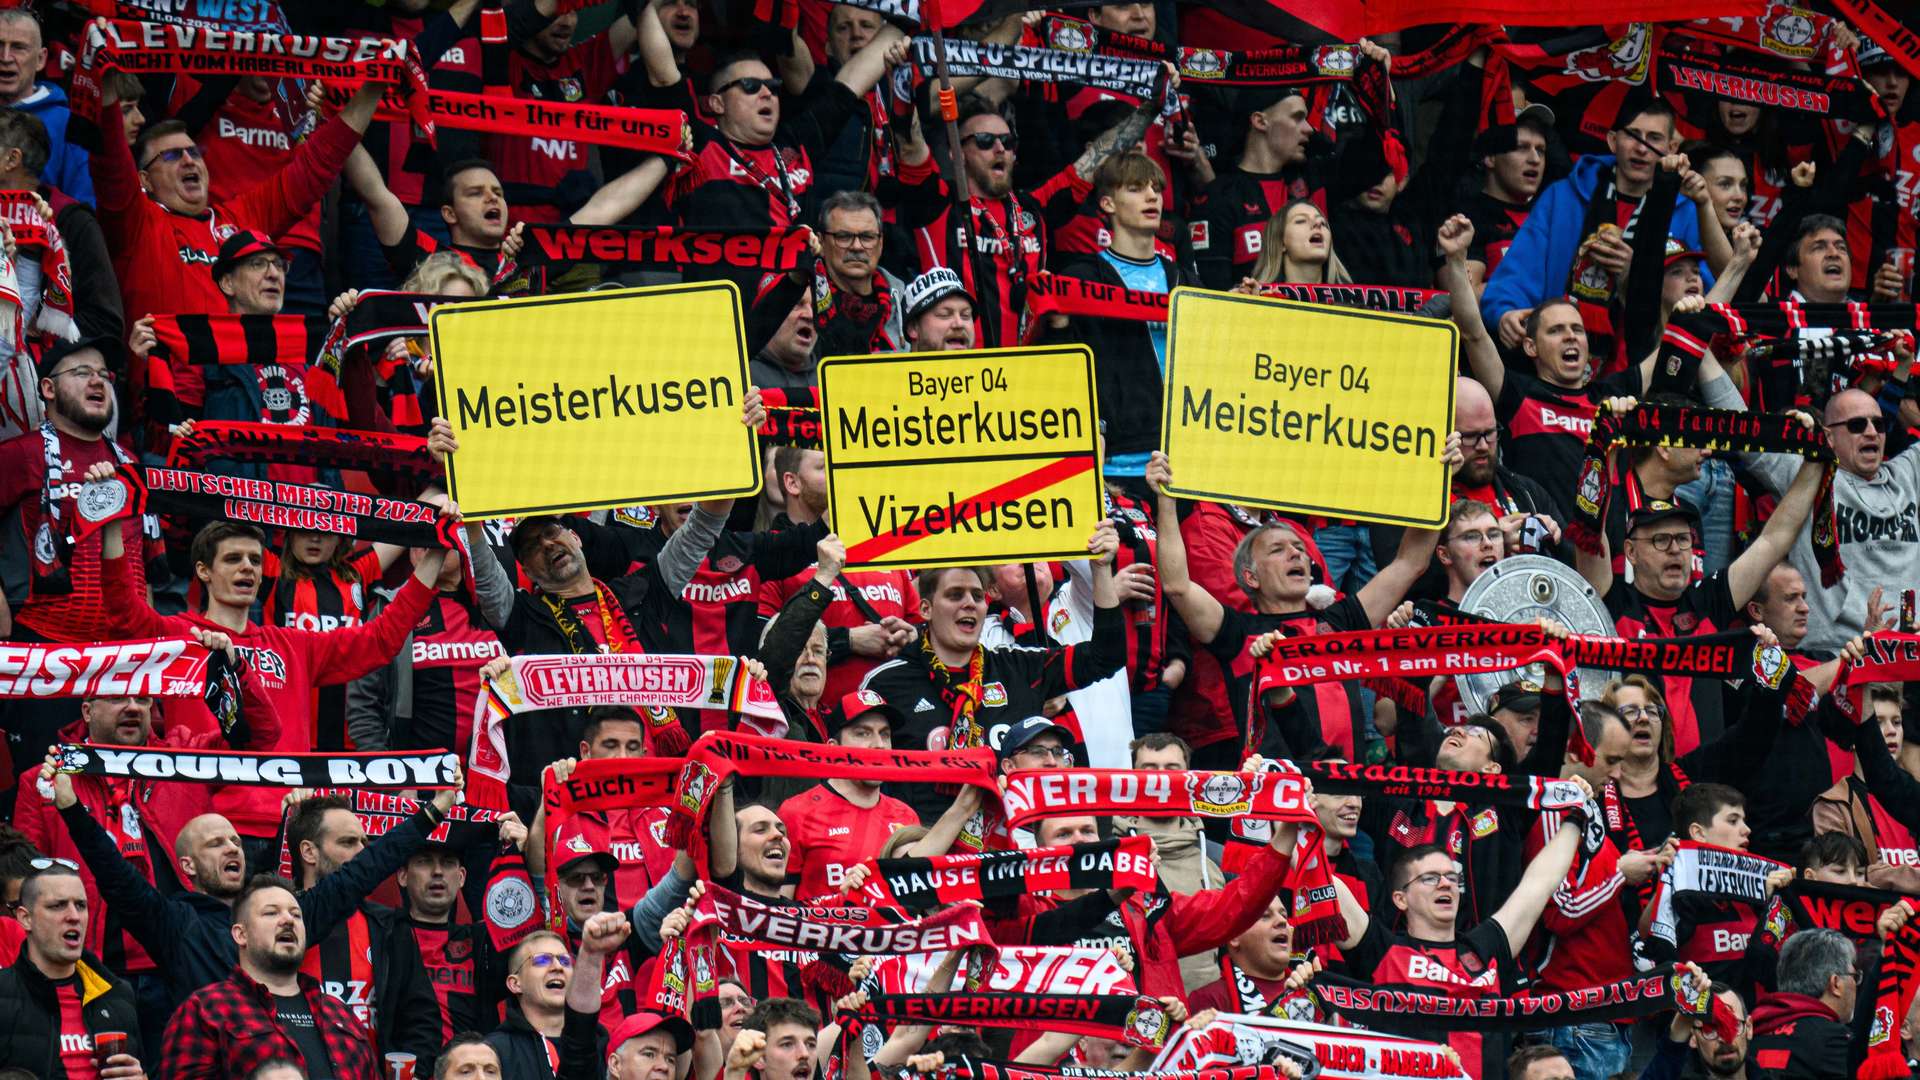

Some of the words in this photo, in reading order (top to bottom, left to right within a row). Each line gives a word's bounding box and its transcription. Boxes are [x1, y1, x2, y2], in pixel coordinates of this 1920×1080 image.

[106, 19, 408, 63] LEVERKUSEN
[179, 52, 226, 71] VOM
[1236, 62, 1308, 78] LEVERKUSEN
[1668, 63, 1831, 114] LEVERKUSEN
[430, 94, 496, 121] Euch
[526, 104, 567, 128] Ihr
[575, 106, 608, 133] für
[622, 118, 672, 140] uns
[531, 225, 811, 271] werkself
[1028, 273, 1071, 297] Wir
[908, 369, 975, 401] Bayer
[981, 367, 1008, 391] 04
[1254, 353, 1332, 391] Bayer
[1339, 364, 1370, 393] 04
[456, 374, 734, 430] Meisterkusen
[838, 400, 1083, 450] Meisterkusen
[1181, 385, 1436, 458] Meisterkusen
[1637, 408, 1662, 430] 04
[1679, 408, 1760, 437] Fanclub
[145, 467, 273, 501] DEUTSCHER
[275, 483, 372, 516] MEISTER
[374, 498, 437, 525] 2024
[224, 499, 358, 537] LEVERKUSEN
[858, 491, 1075, 538] Vizekusen
[562, 656, 588, 666] TSV
[595, 655, 636, 666] BAYER
[645, 655, 662, 664] 04
[1324, 638, 1366, 655] 04
[1661, 644, 1735, 674] DABEI
[537, 666, 690, 696] LEVERKUSEN
[1283, 664, 1327, 683] Die
[1333, 660, 1371, 677] Nr.
[1377, 657, 1389, 672] 1
[1400, 658, 1430, 671] am
[1446, 652, 1519, 670] Rhein
[166, 681, 204, 697] 2024
[545, 696, 563, 707] WE
[567, 695, 590, 706] ARE
[592, 694, 615, 705] THE
[619, 693, 685, 706] CHAMPIONS
[94, 749, 304, 786] YOUNG
[568, 775, 636, 803] Euch
[1109, 774, 1171, 804] 04
[1194, 801, 1248, 815] Leverkusen
[827, 826, 850, 838] JAKO
[889, 866, 977, 896] HAUSE
[987, 854, 1071, 881] IMMER
[1080, 850, 1157, 879] DABEI
[1311, 885, 1336, 901] CLUB
[885, 995, 1101, 1020] LEVERKUSEN
[1316, 984, 1516, 1018] LEVERKUSEN
[1521, 987, 1564, 1015] 04
[1570, 975, 1665, 1010] BAYER
[1062, 1067, 1083, 1076] DIE
[1085, 1068, 1129, 1079] MACHT
